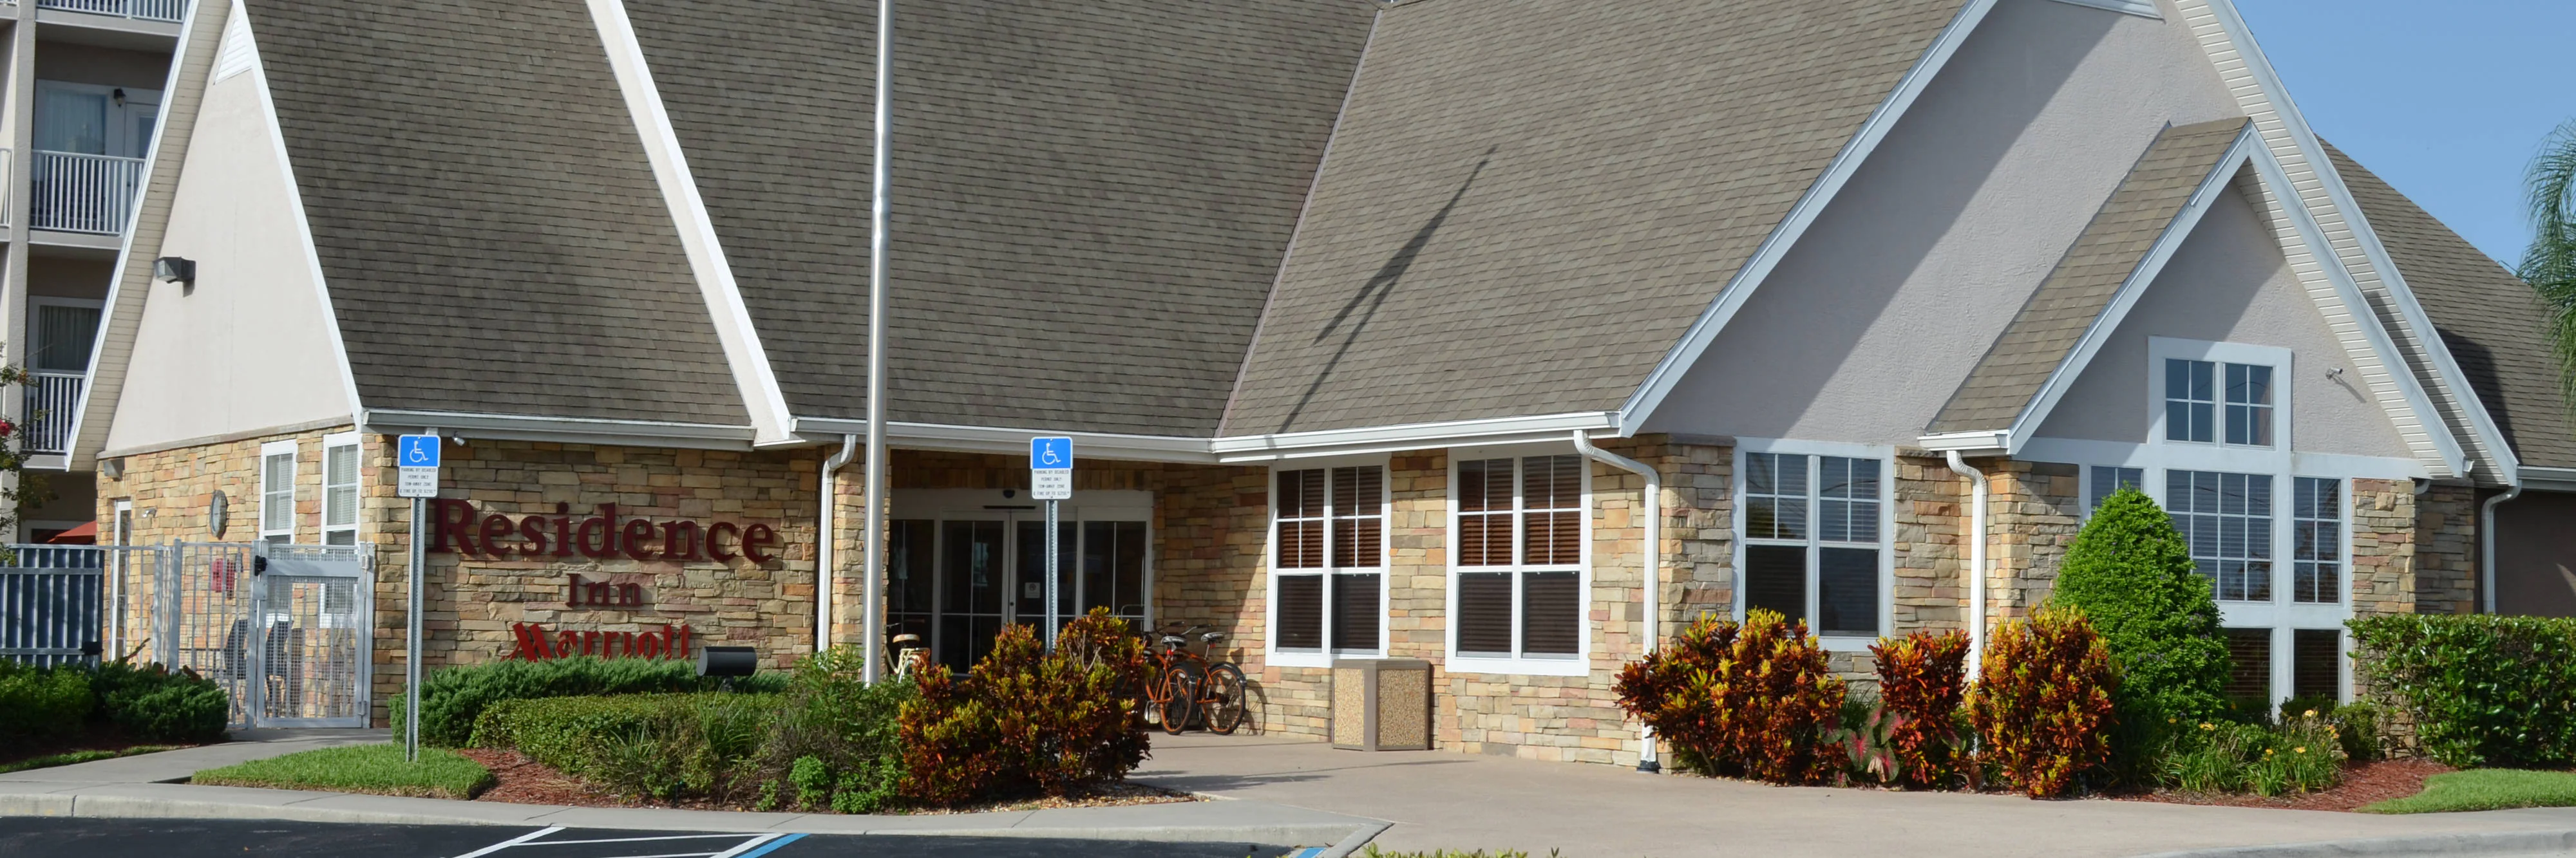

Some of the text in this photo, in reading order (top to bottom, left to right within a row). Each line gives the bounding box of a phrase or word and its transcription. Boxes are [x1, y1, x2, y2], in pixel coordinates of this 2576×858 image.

[428, 499, 774, 563] Residence
[566, 574, 643, 608] Inn
[501, 622, 692, 663] Marriott
